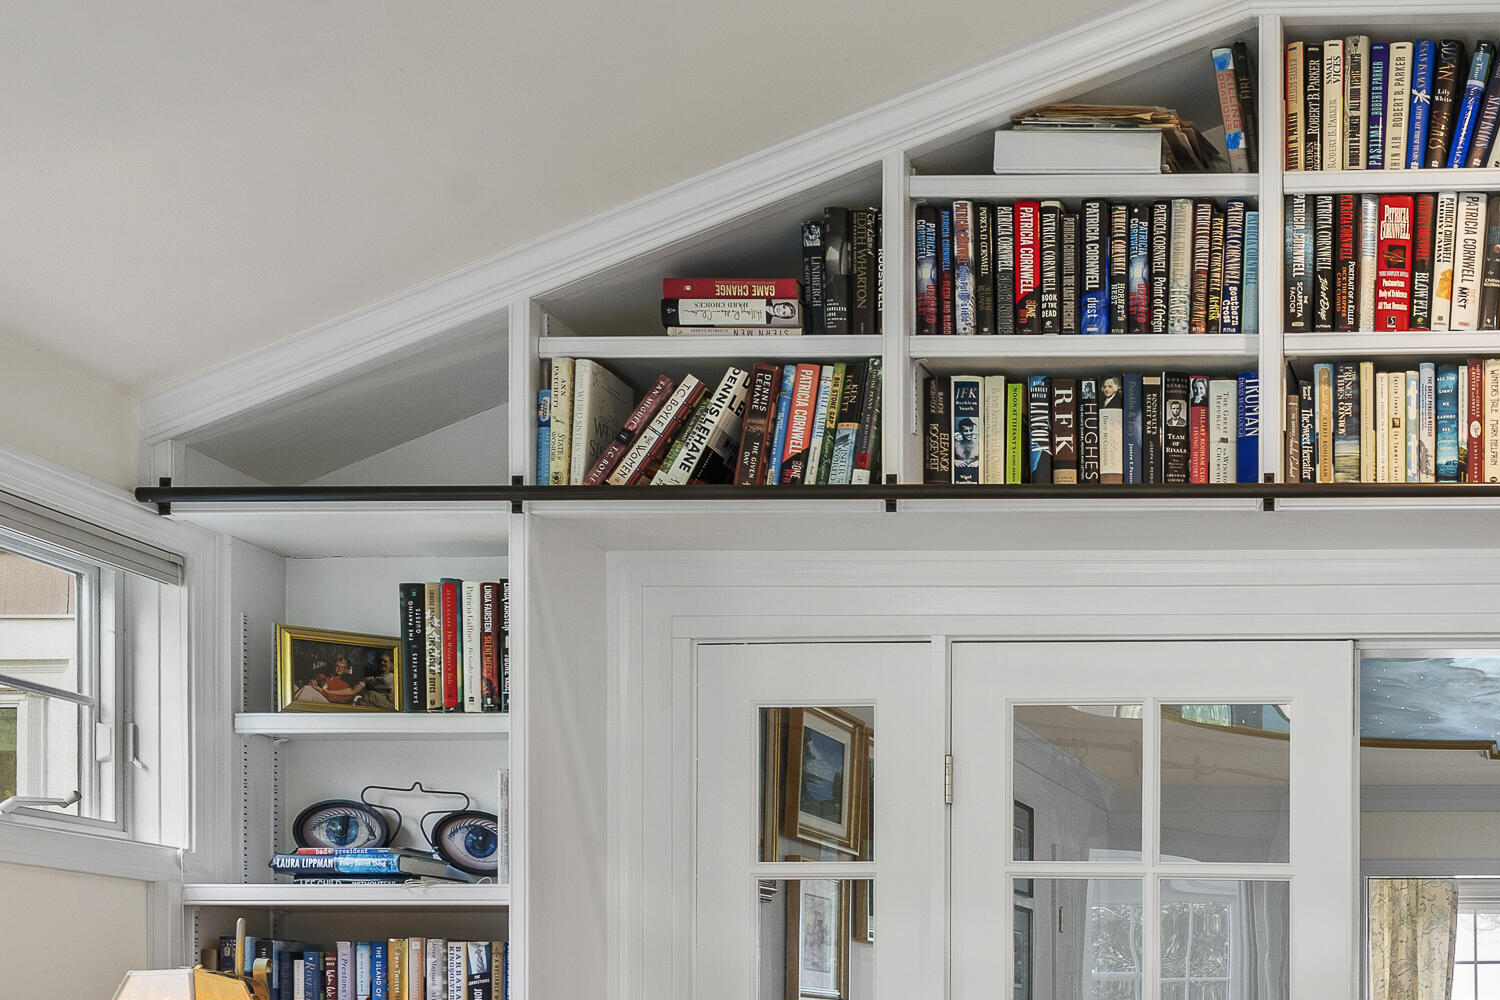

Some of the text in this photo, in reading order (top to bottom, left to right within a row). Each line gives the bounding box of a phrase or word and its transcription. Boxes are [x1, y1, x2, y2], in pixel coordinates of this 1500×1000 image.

[1218, 74, 1232, 131] DRAGONS
[1227, 71, 1240, 128] KILLING
[1428, 40, 1456, 152] SUSAN ISAACS
[1020, 207, 1032, 294] PATRICIA CORNWELL
[1087, 203, 1099, 318] PATRICIA CORNWELL dust
[1461, 196, 1479, 283] PATRICIA CORNWELL
[715, 285, 775, 296] GAME CHANGE
[811, 256, 822, 306] LINDBERGH
[752, 373, 764, 410] LEHANE
[759, 373, 772, 411] DENNIS
[789, 369, 812, 453] PATRICIA CORNWELL
[679, 418, 712, 473] LEHANE
[930, 423, 938, 470] ROOSEVELT
[1085, 403, 1098, 480] HUGHES
[1302, 409, 1313, 480] The Sweet Hereafter
[484, 586, 492, 632] LINDA FAIRSTEIN
[276, 856, 333, 868] LAURA LIPPMAN
[376, 988, 381, 997] OF
